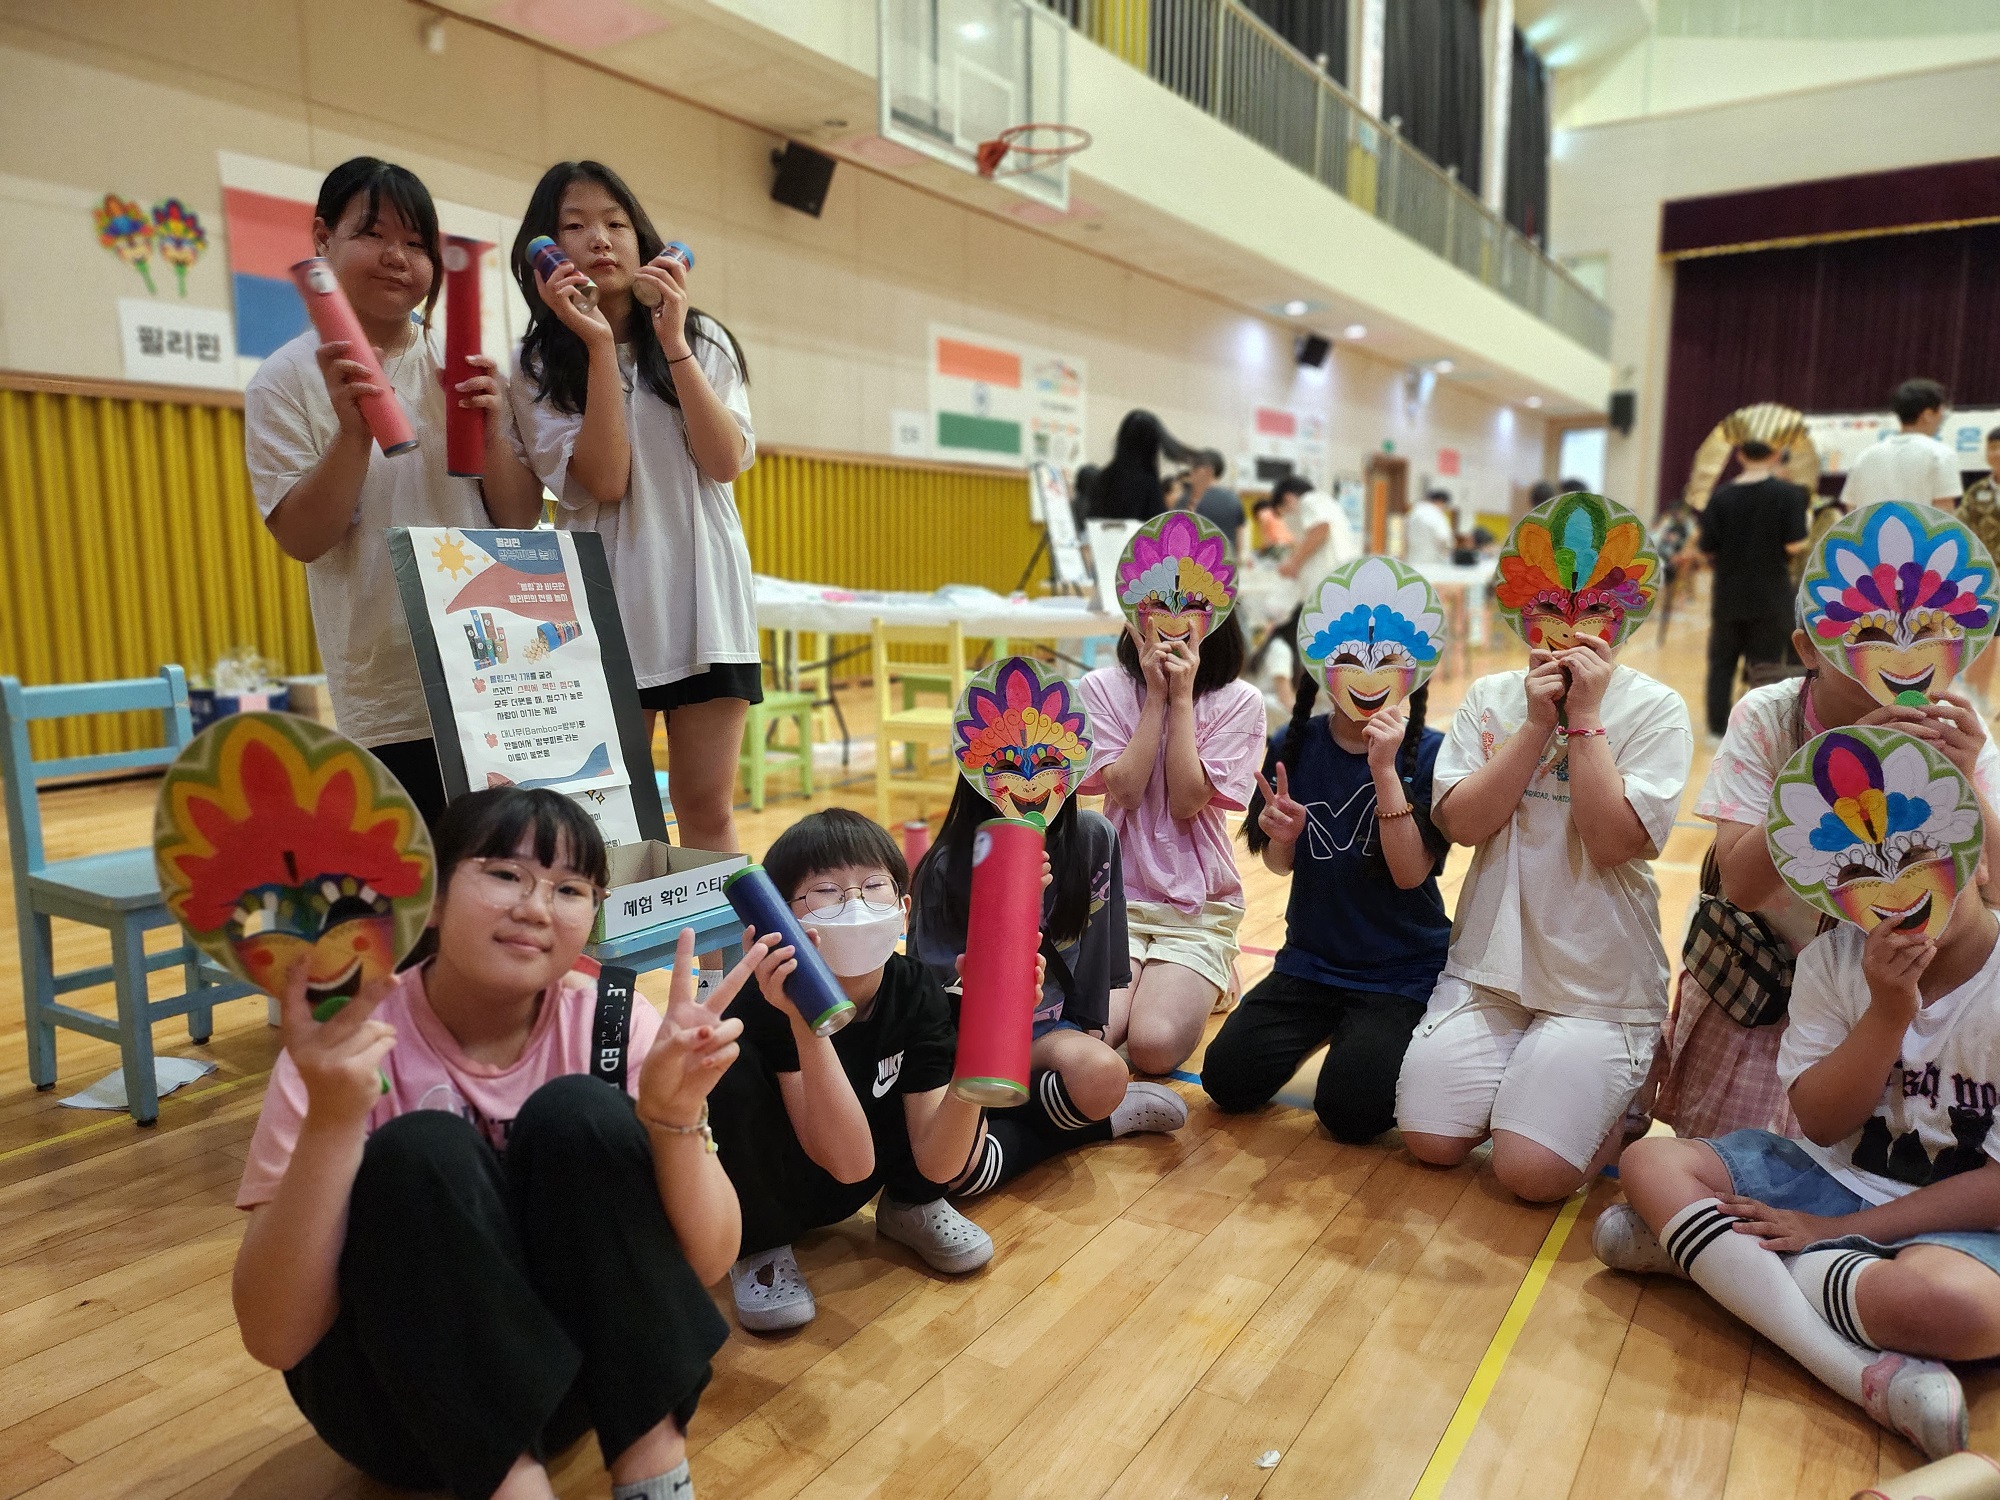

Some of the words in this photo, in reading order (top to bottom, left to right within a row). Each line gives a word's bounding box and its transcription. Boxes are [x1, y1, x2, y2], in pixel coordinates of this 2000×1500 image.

[138, 326, 221, 363] 필리핀
[492, 686, 513, 696] 쓰러진
[517, 684, 538, 694] 스틱에
[542, 682, 556, 691] 적힌
[560, 680, 581, 689] 점수를
[494, 699, 509, 708] 모두
[546, 693, 568, 703] 점수가
[497, 710, 519, 721] 사람이
[520, 708, 541, 718] 이기는
[543, 706, 557, 716] 게임
[504, 739, 532, 751] 만들어서
[507, 751, 528, 762] 이름이
[623, 895, 653, 917] 체험
[660, 885, 688, 907] 확인
